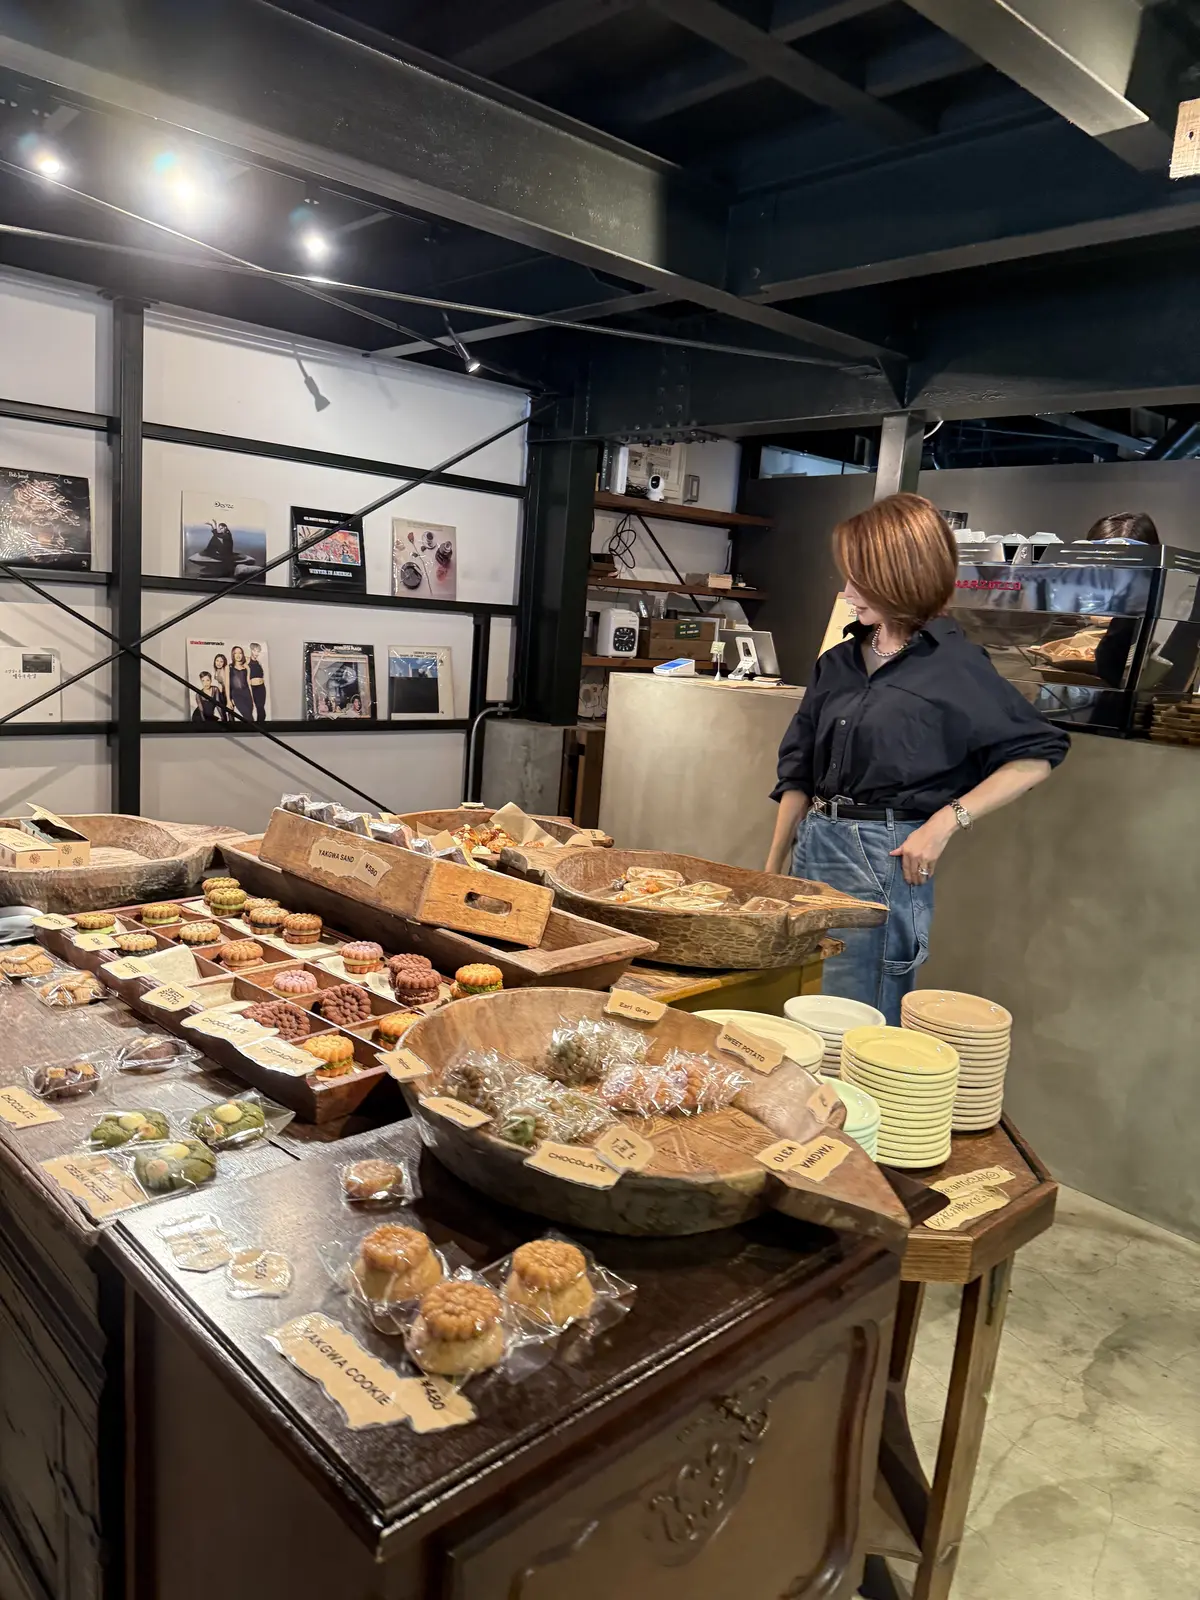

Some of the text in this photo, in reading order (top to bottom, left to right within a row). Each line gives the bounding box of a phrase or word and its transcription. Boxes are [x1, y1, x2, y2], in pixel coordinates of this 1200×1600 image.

[318, 849, 355, 863] YAKGWA SAND
[201, 1017, 249, 1035] CHOCOLATE
[723, 1033, 766, 1062] SWEET POTATO
[0, 1094, 37, 1120] CHOCOLATE
[548, 1152, 608, 1173] CHOCOLATE
[773, 1145, 798, 1163] ¥310
[800, 1143, 835, 1169] YAKGWA
[63, 1163, 114, 1204] CREAM CHEESE
[303, 1327, 391, 1407] YAKGWA COOKIE
[419, 1379, 446, 1411] ¥480
